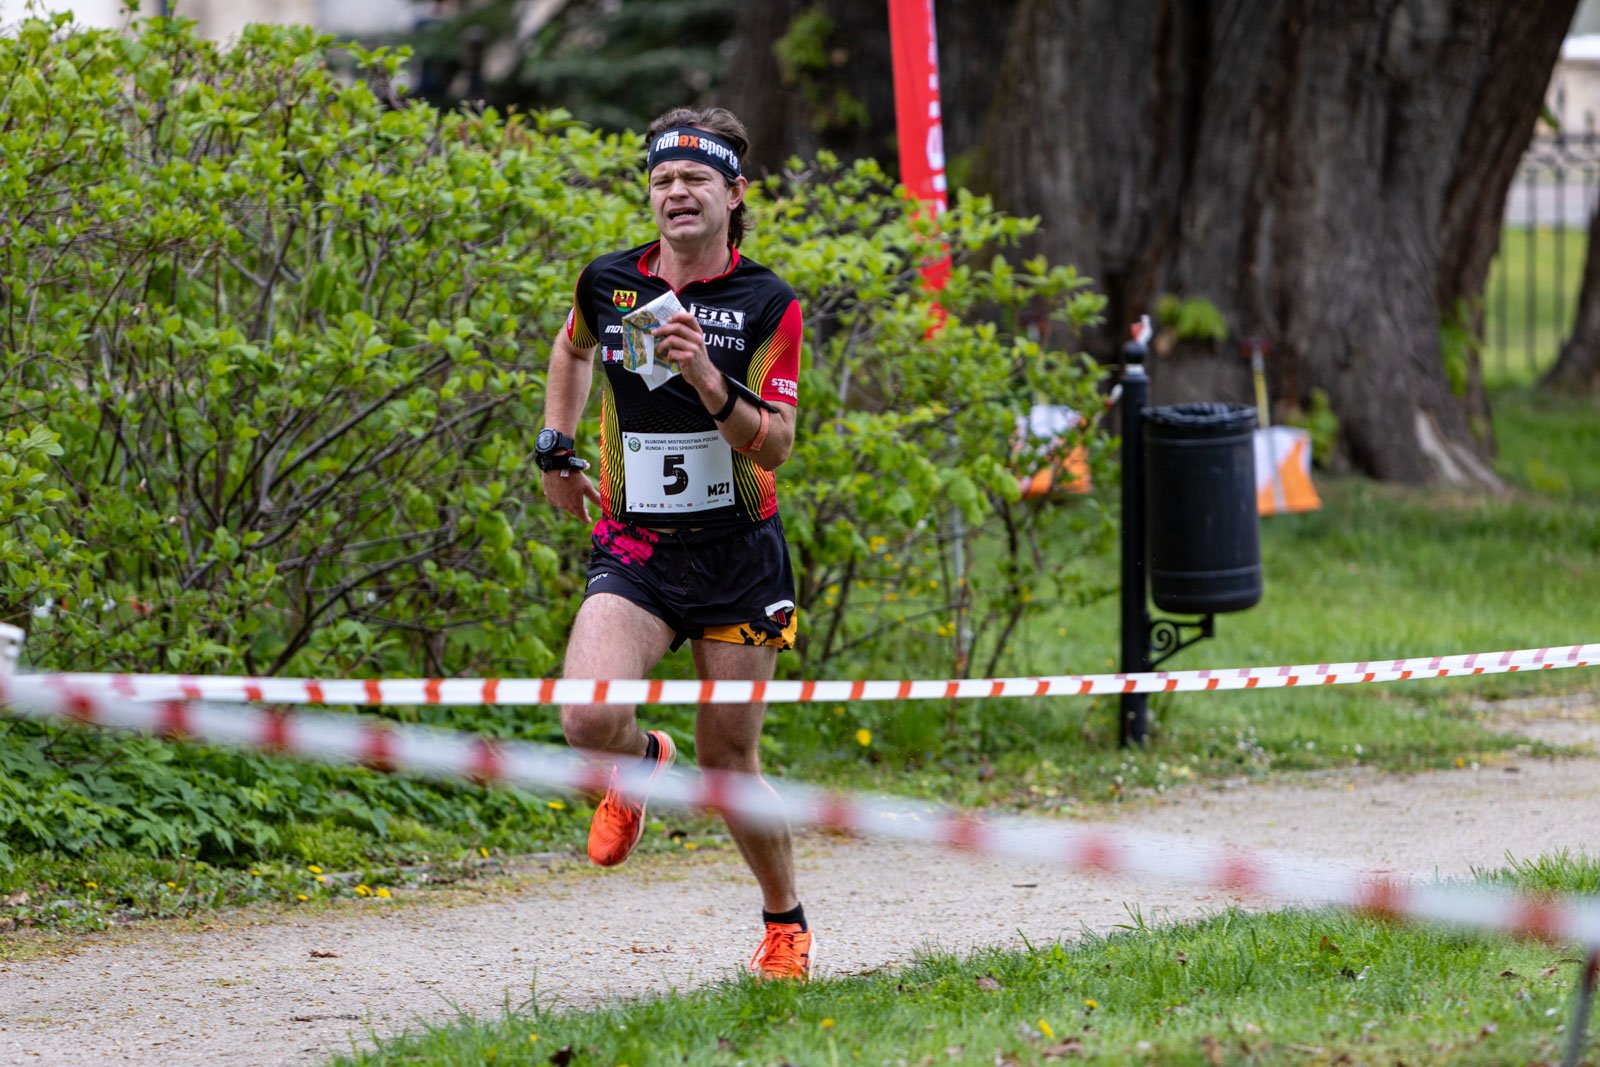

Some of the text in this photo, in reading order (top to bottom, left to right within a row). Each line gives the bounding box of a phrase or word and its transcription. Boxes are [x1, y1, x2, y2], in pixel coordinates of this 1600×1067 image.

[655, 135, 738, 169] runexsports
[663, 454, 689, 496] 5
[707, 482, 730, 497] M21
